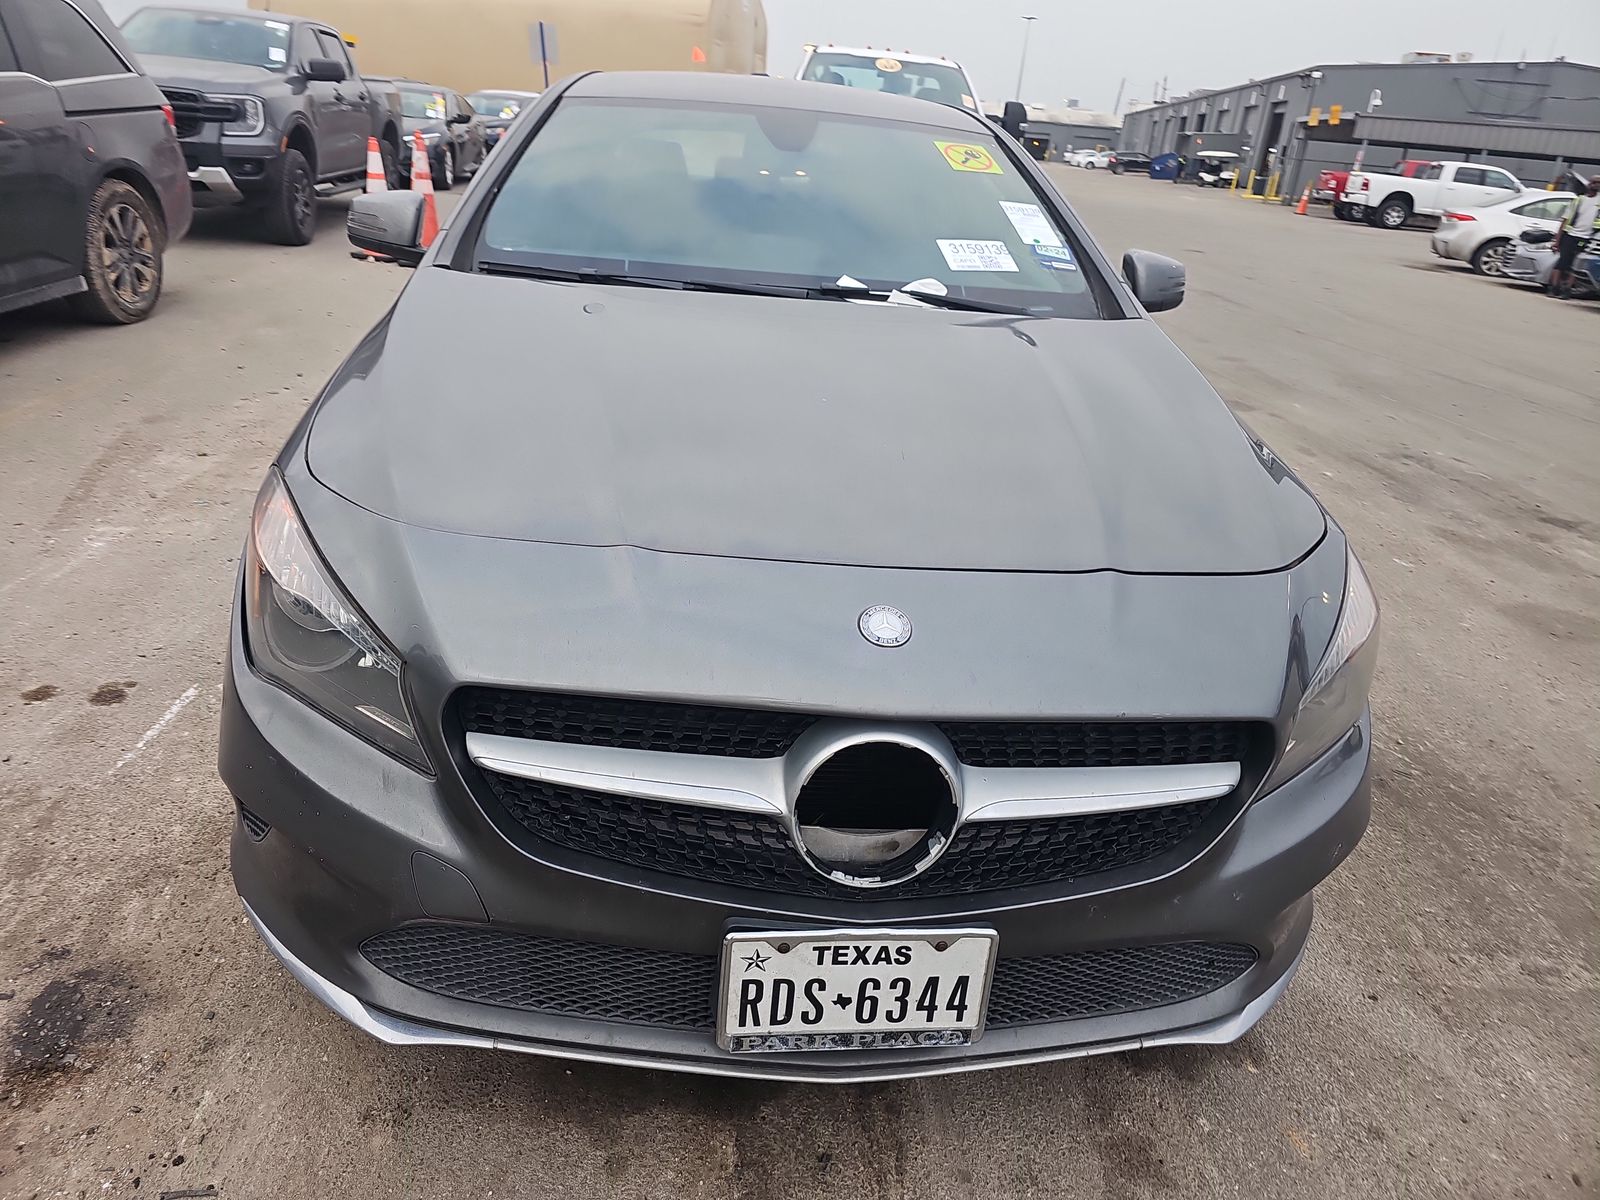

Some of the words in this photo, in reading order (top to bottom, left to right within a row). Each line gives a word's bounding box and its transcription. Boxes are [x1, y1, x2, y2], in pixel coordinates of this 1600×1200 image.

[812, 945, 912, 966] TEXAS
[740, 1034, 842, 1049] PARK
[851, 1031, 964, 1048] PLACE
